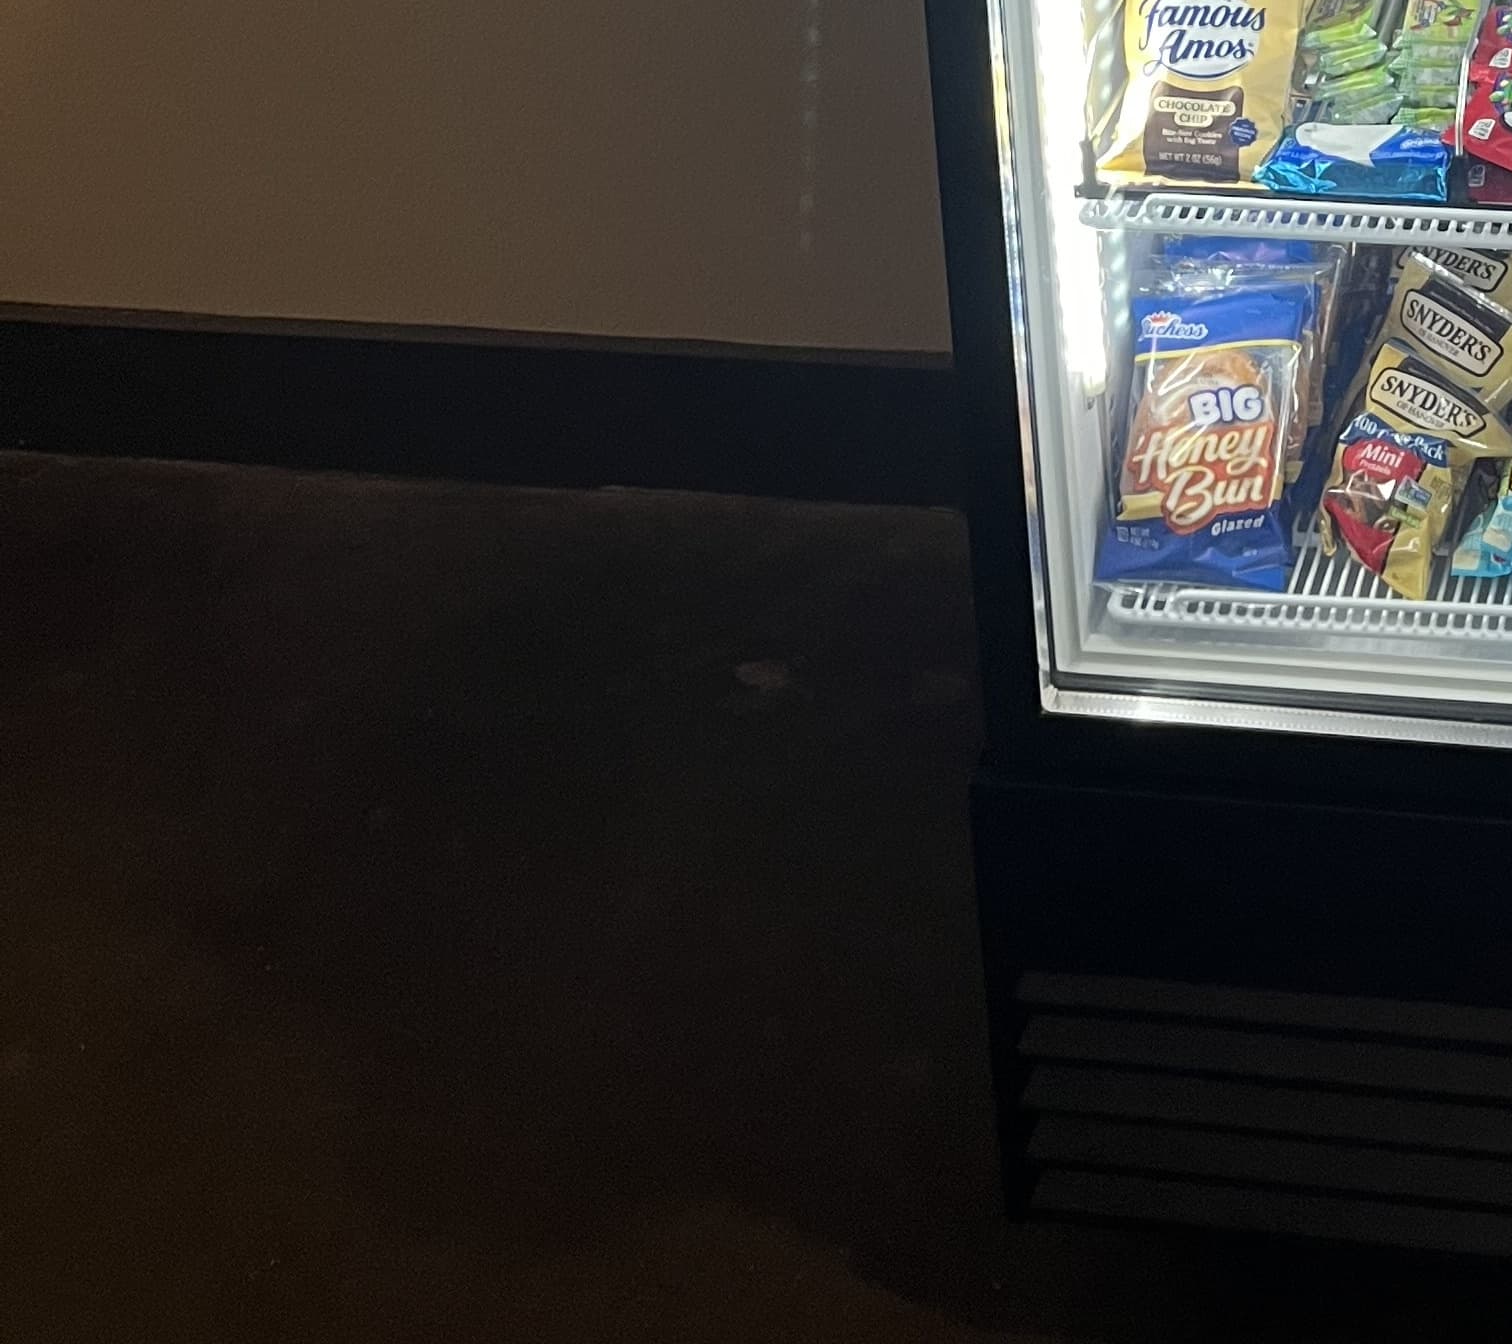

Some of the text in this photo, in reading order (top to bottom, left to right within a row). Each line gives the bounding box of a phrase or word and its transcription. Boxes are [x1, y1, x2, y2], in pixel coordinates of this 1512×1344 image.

[1143, 29, 1255, 77] Amos
[1159, 100, 1232, 113] CHOCOLATE
[1180, 112, 1208, 123] CHIP
[1406, 298, 1492, 362] SNYDER'S
[1189, 388, 1263, 423] BIG
[1381, 375, 1476, 429] SNYDER'S
[1133, 423, 1267, 483] Honey
[1361, 443, 1405, 465] Mini
[1164, 467, 1264, 524] Bun
[1211, 515, 1264, 536] Glazed
